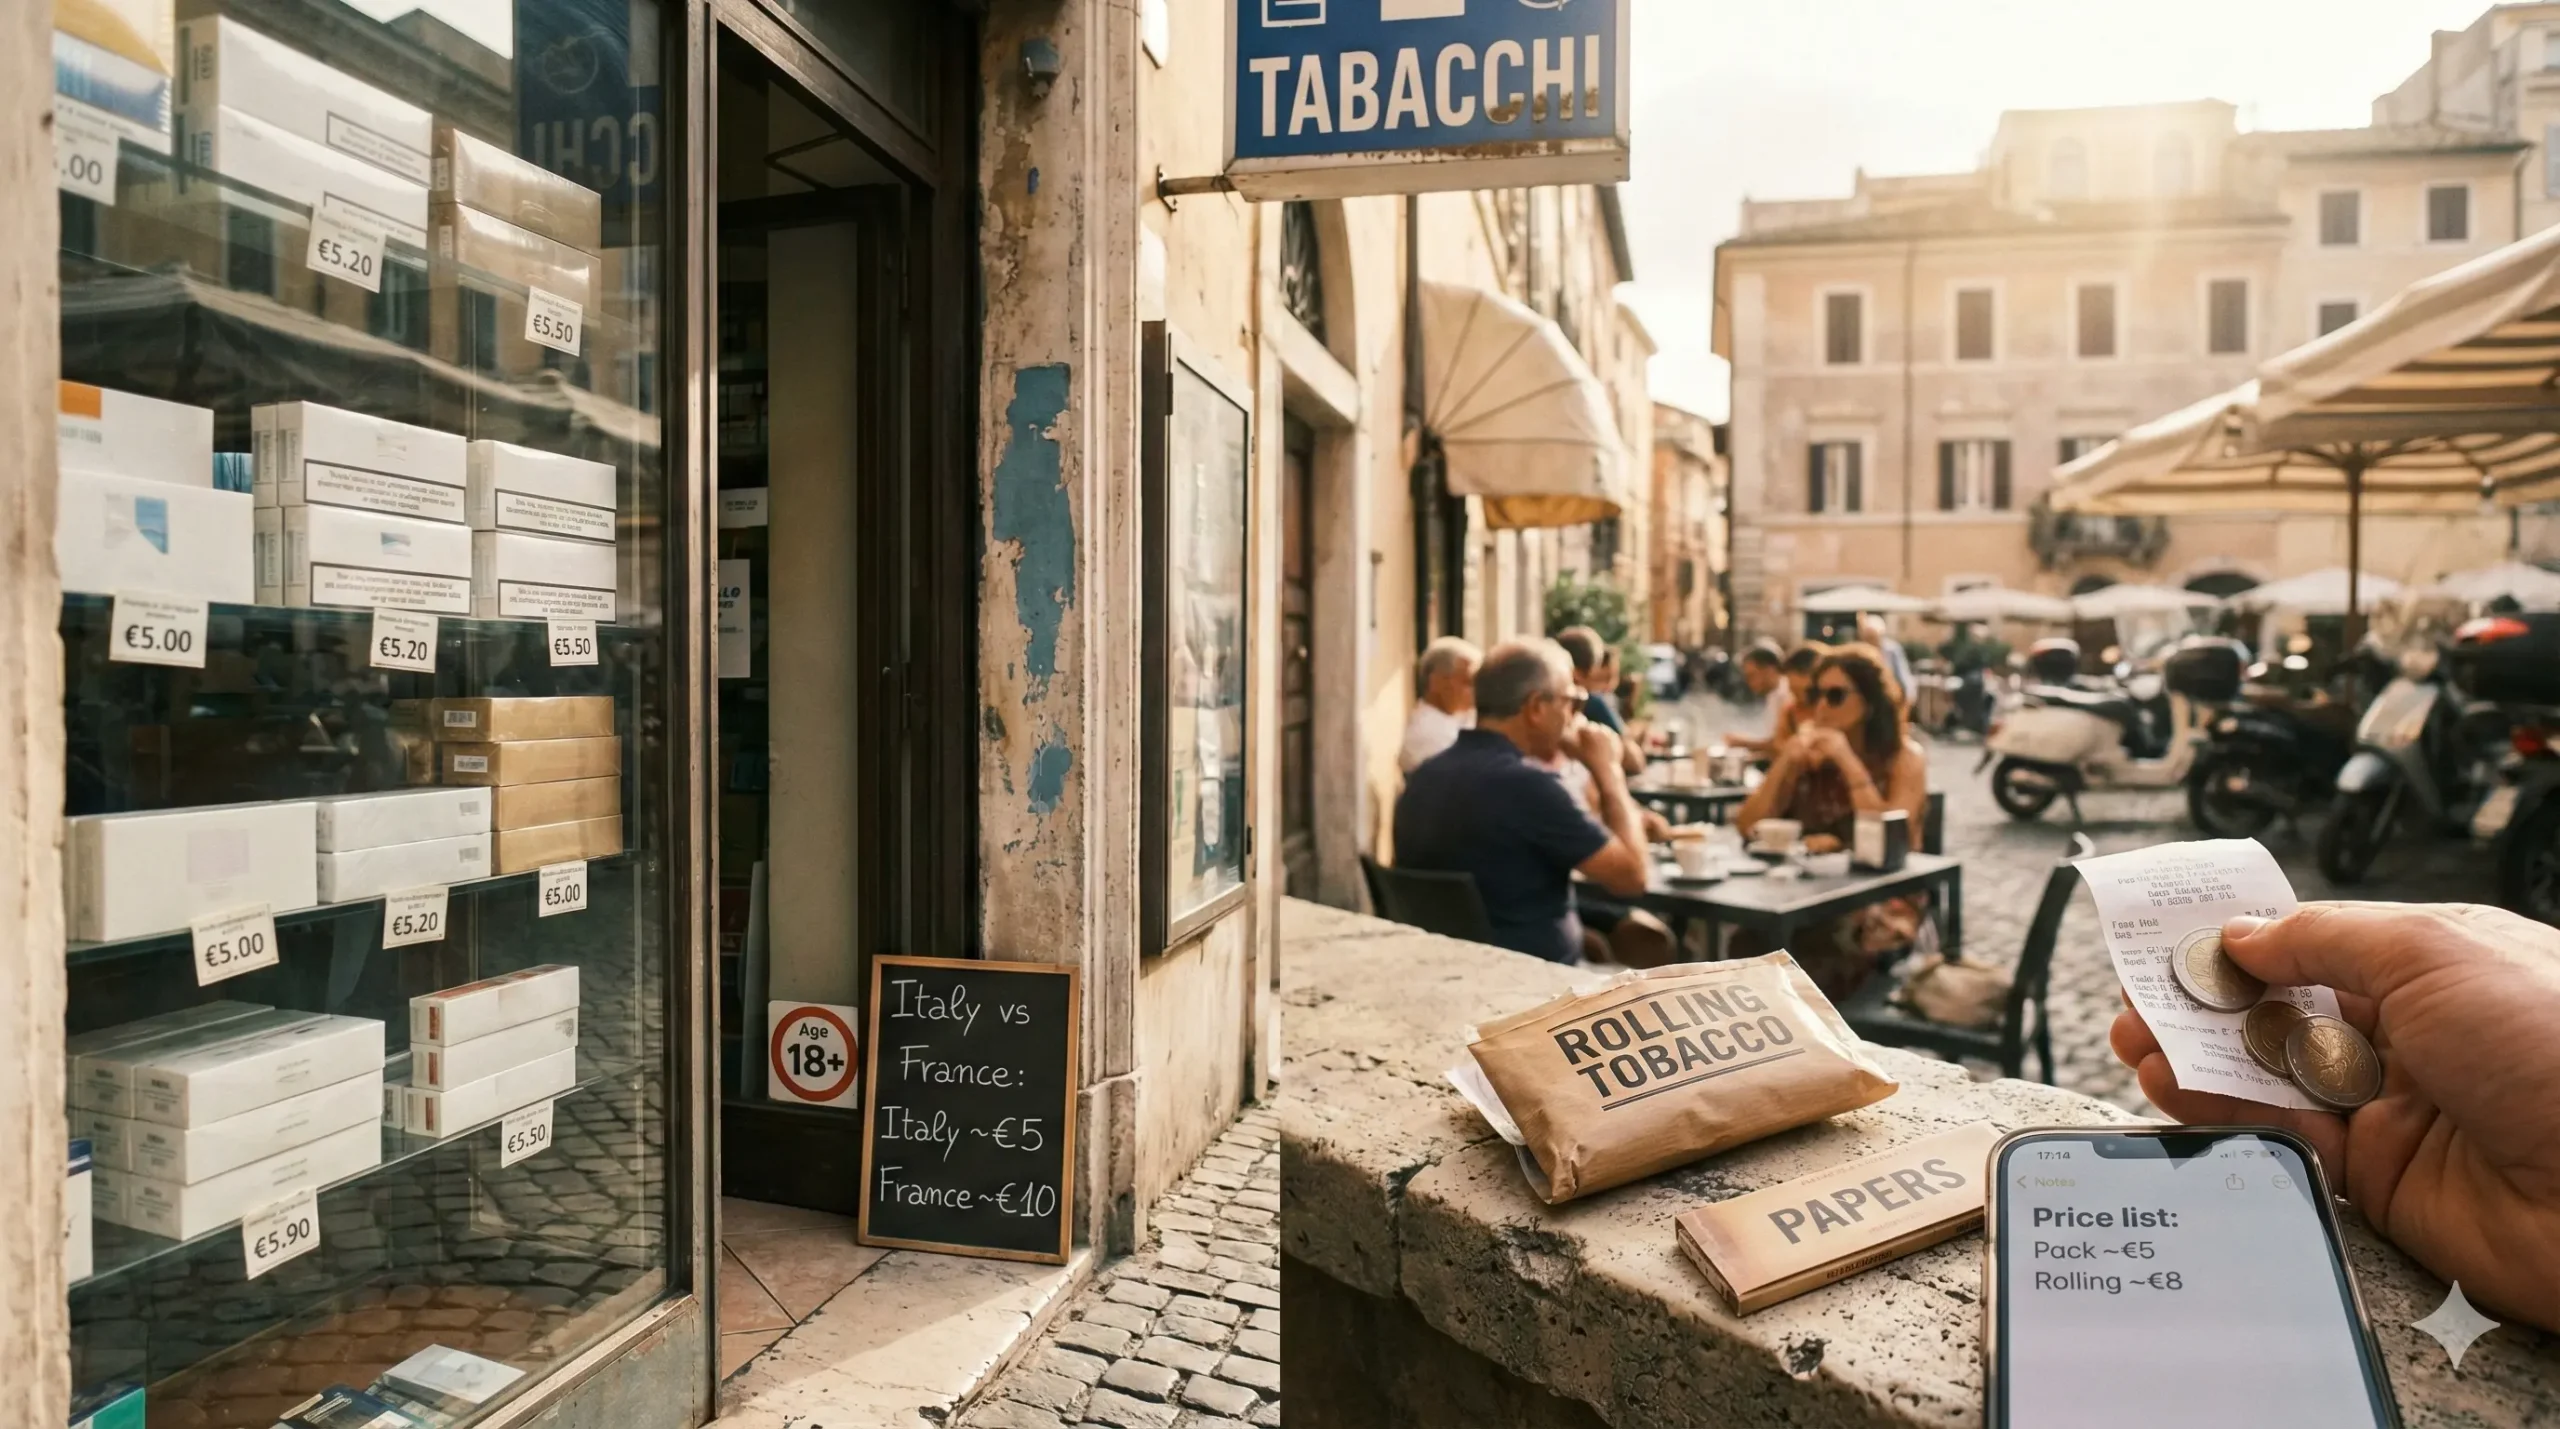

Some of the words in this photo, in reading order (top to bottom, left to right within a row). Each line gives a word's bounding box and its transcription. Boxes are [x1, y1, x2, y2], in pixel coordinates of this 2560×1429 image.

[1249, 34, 1600, 137] TABACCHI
[317, 238, 373, 276] €5.20
[533, 313, 573, 343] €5.50
[125, 624, 192, 653] €5.00
[379, 636, 428, 661] €5.20
[554, 637, 591, 656] €5.50
[545, 883, 581, 906] €5.00
[392, 911, 438, 936] €5.20
[205, 932, 264, 968] €5.00
[890, 979, 981, 1036] Italy
[999, 1003, 1031, 1025] vs
[798, 1022, 829, 1040] Age
[1553, 984, 1769, 1065] ROLLING
[786, 1043, 845, 1078] 18+
[900, 1044, 1024, 1087] France:
[1576, 1015, 1794, 1098] TOBACCO
[507, 1123, 546, 1153] €5.50
[881, 1106, 960, 1162] Italy
[2037, 1151, 2071, 1161] 17:14
[880, 1165, 974, 1209] France
[978, 1181, 1056, 1217] ~€10
[2034, 1176, 2076, 1188] Notes
[1767, 1158, 1967, 1245] PAPERS
[2033, 1206, 2114, 1228] Price
[2121, 1206, 2179, 1228] list:
[253, 1217, 310, 1259] €5.90
[2034, 1241, 2097, 1259] Pack
[2103, 1241, 2156, 1260] ~€5
[2035, 1271, 2122, 1295] Rolling
[2129, 1271, 2183, 1291] ~€8
